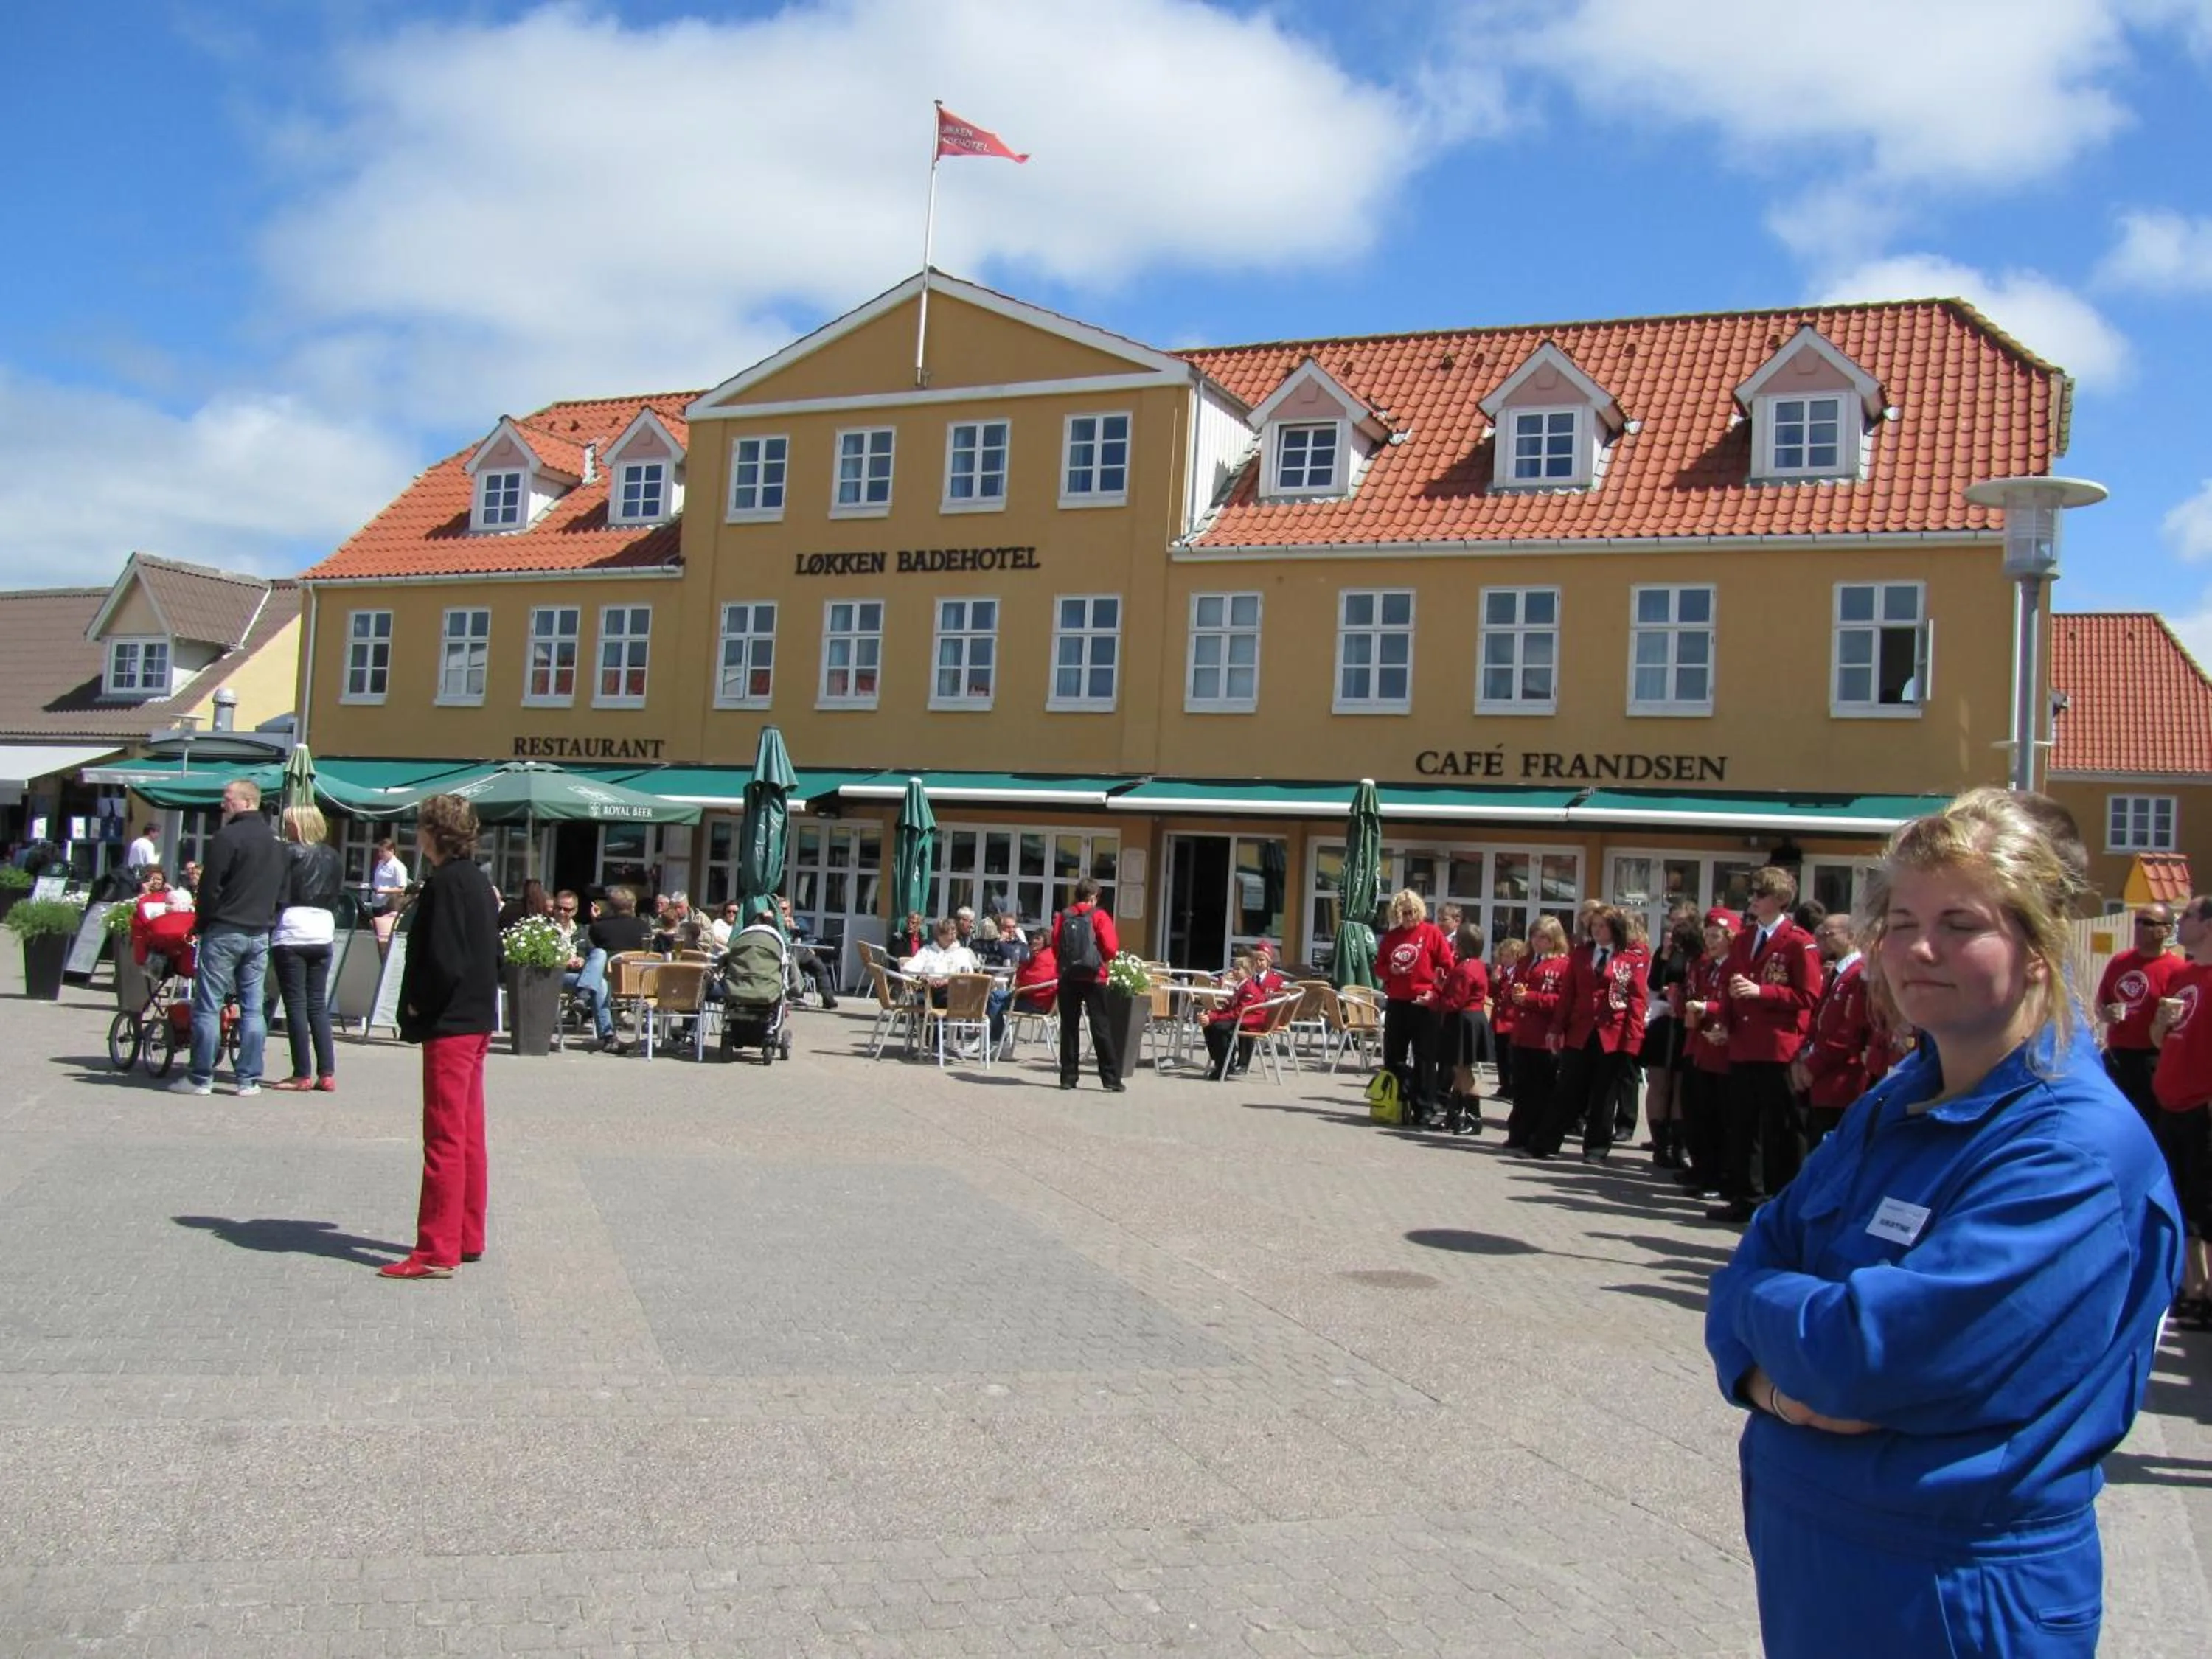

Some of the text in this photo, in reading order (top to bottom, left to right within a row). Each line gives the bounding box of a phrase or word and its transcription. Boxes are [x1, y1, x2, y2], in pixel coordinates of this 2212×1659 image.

[795, 547, 1041, 576] LØKKEN BADEHOTEL
[513, 737, 665, 758] RESTAURANT
[1415, 743, 1728, 781] CAFÉ FRANDSEN
[603, 805, 653, 818] ROYAL BEER
